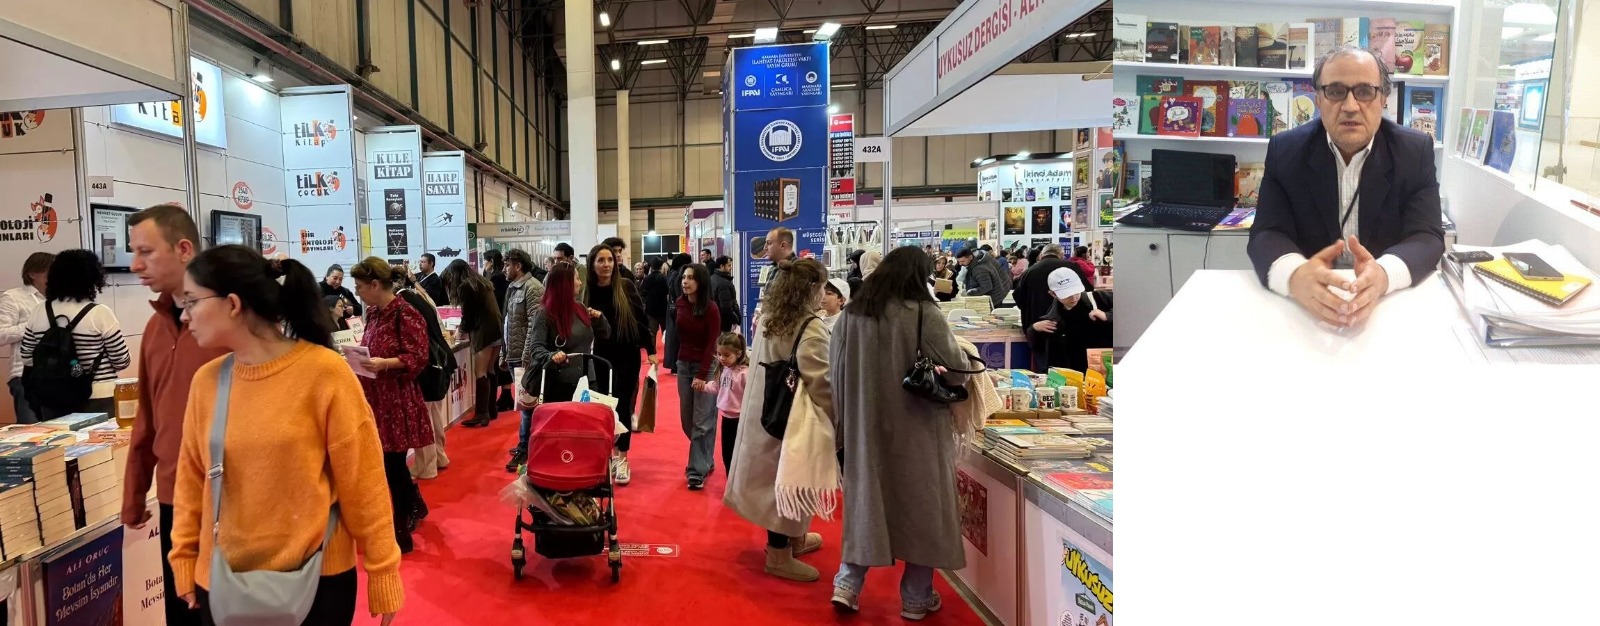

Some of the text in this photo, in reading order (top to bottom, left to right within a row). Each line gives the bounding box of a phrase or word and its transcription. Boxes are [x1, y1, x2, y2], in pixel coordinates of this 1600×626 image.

[938, 30, 973, 79] UYKUSUZ
[862, 145, 882, 153] 432A
[376, 152, 409, 164] KULE
[377, 165, 411, 178] KİTAP
[1046, 169, 1072, 177] Adam
[427, 173, 457, 183] HARP
[91, 182, 107, 190] 443A
[427, 184, 458, 195] SANAT
[148, 526, 160, 540] AL
[145, 575, 163, 591] Bota
[1064, 546, 1113, 615] UYKUSUZ
